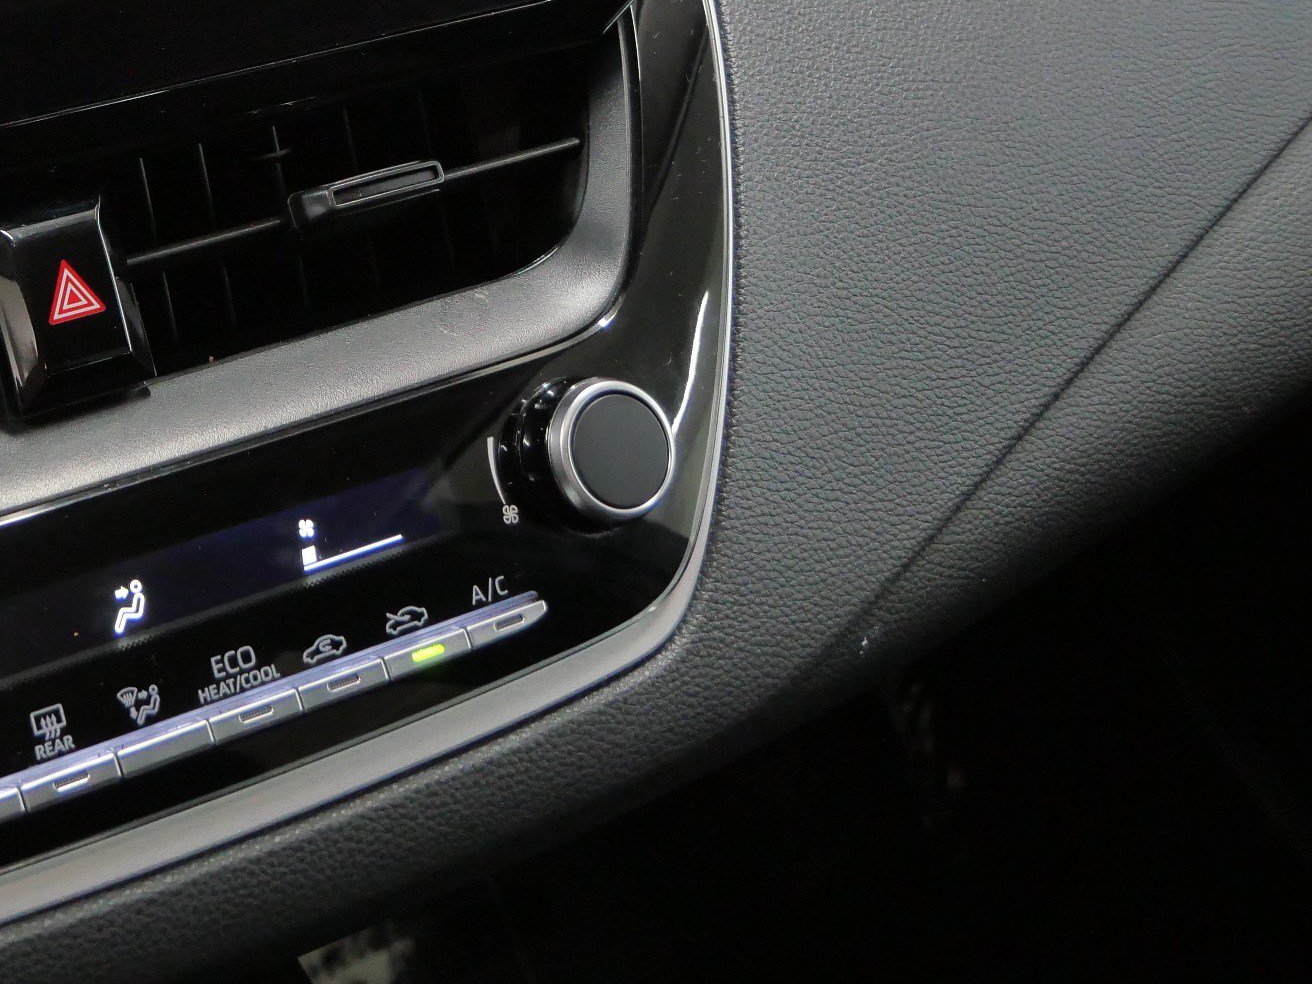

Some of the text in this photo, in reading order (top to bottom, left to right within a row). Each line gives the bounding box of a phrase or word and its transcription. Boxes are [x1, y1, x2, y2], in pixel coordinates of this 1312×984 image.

[471, 575, 509, 605] A/C
[211, 645, 257, 679] ECO
[197, 664, 282, 704] HEAT/COOL
[35, 734, 76, 760] REAR
